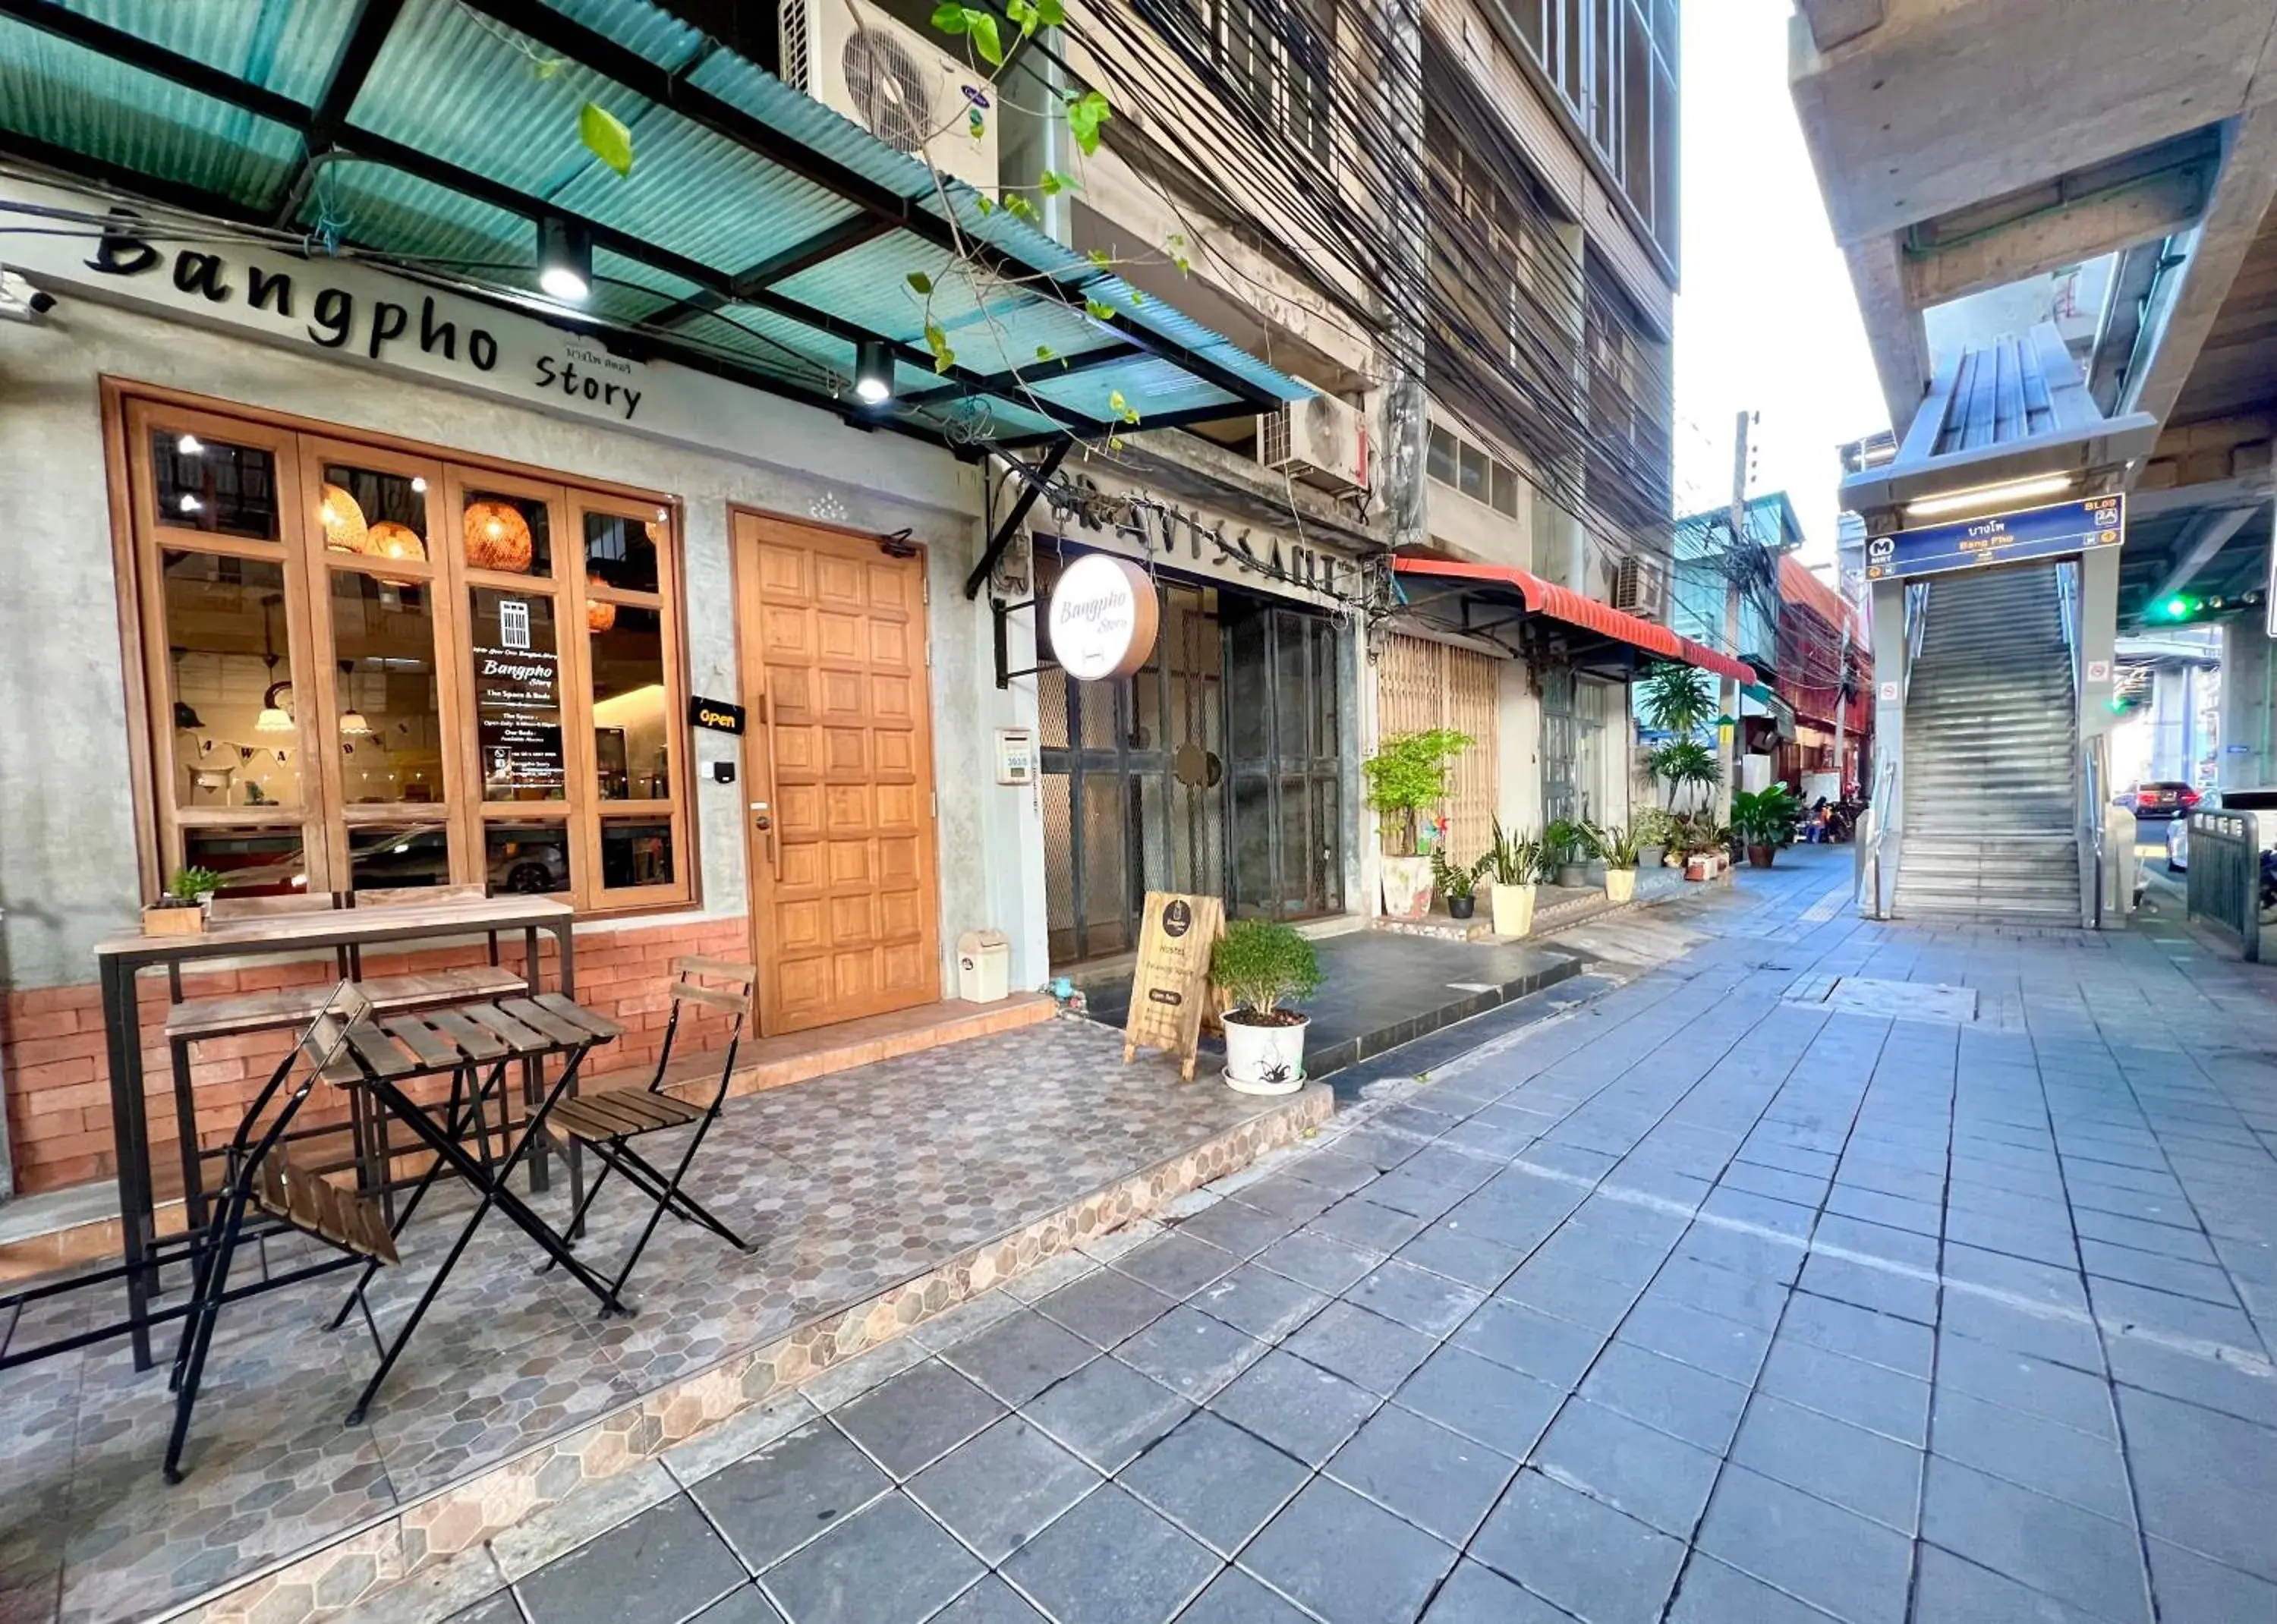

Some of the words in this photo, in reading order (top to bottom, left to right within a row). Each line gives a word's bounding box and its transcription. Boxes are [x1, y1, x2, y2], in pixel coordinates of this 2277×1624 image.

[83, 206, 497, 371] Bangpho
[1968, 520, 2005, 537] บางโพ
[1960, 540, 1988, 550] Bang
[1991, 534, 2015, 545] Pho
[1871, 555, 1892, 564] MRT
[1060, 590, 1127, 626] Bangpho
[481, 659, 553, 680] Bangpho
